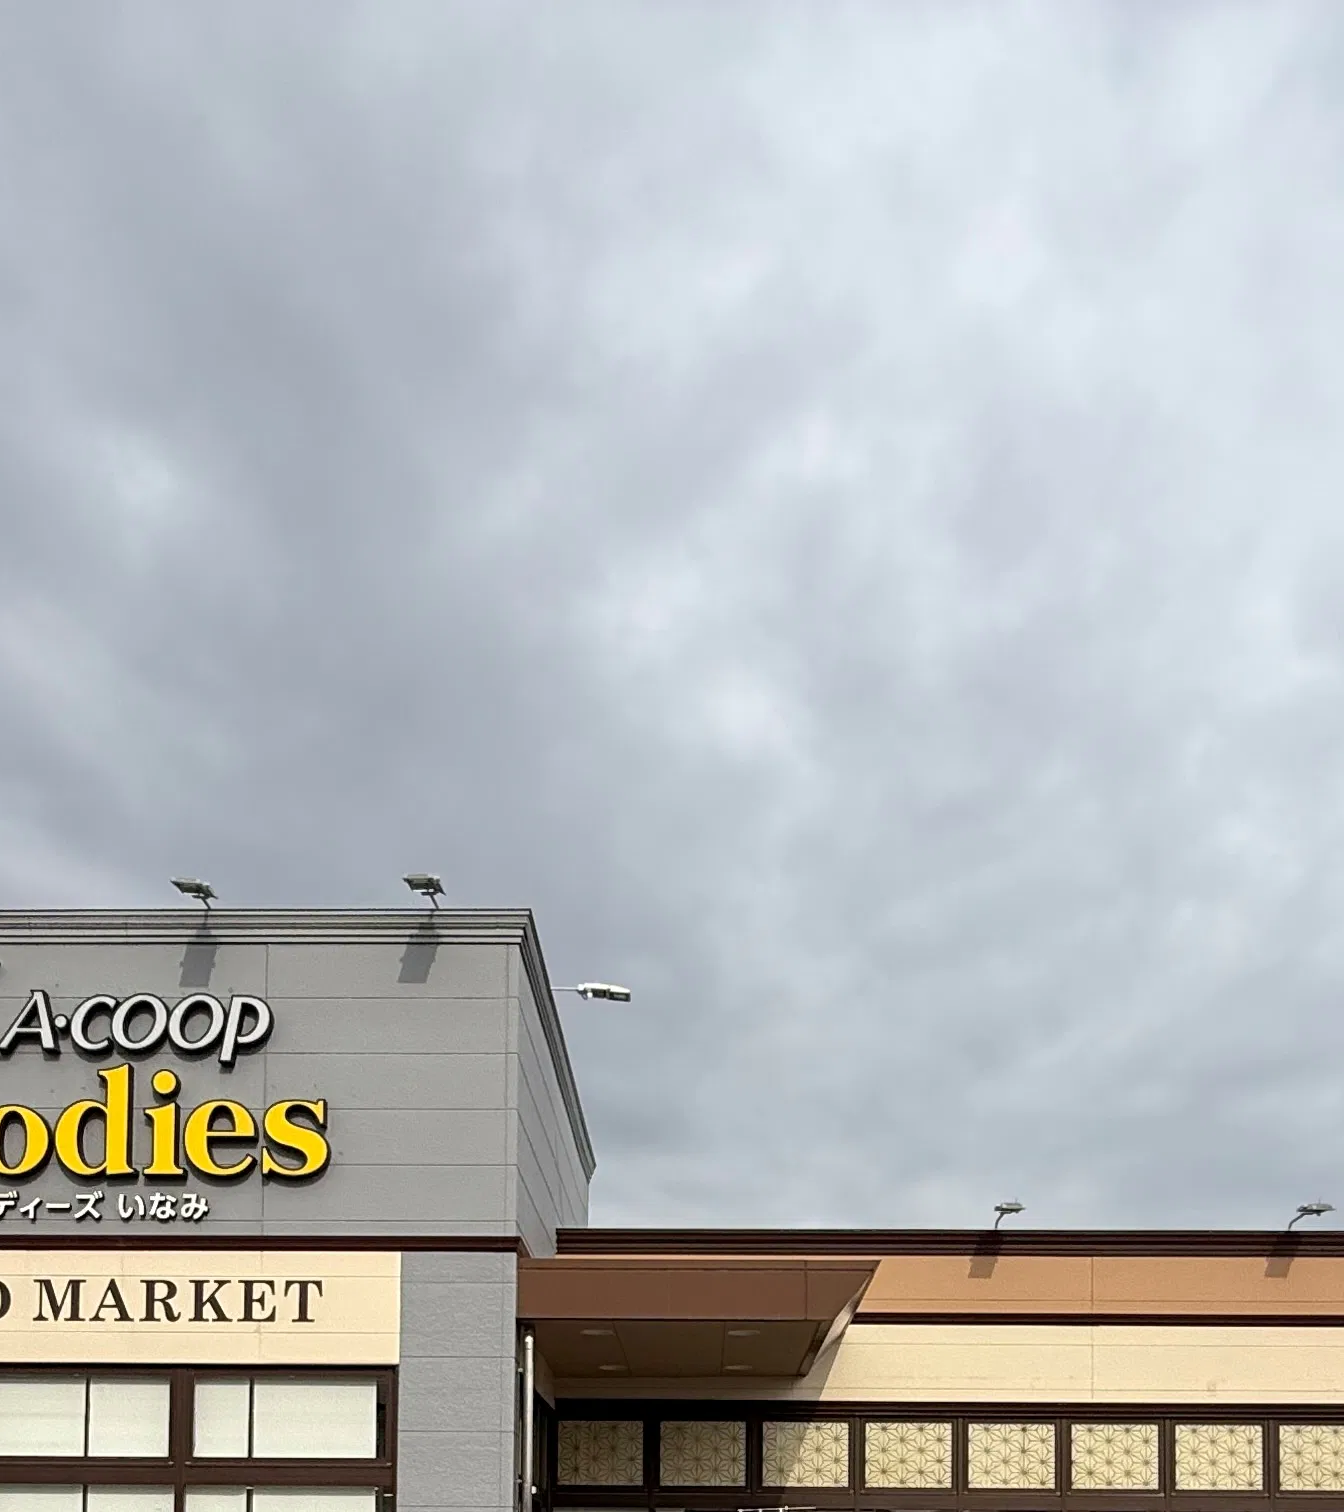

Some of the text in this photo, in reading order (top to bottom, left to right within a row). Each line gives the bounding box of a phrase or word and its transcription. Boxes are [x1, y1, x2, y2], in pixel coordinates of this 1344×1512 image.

[118, 1192, 210, 1220] いなみ
[32, 1278, 324, 1323] MARKET
